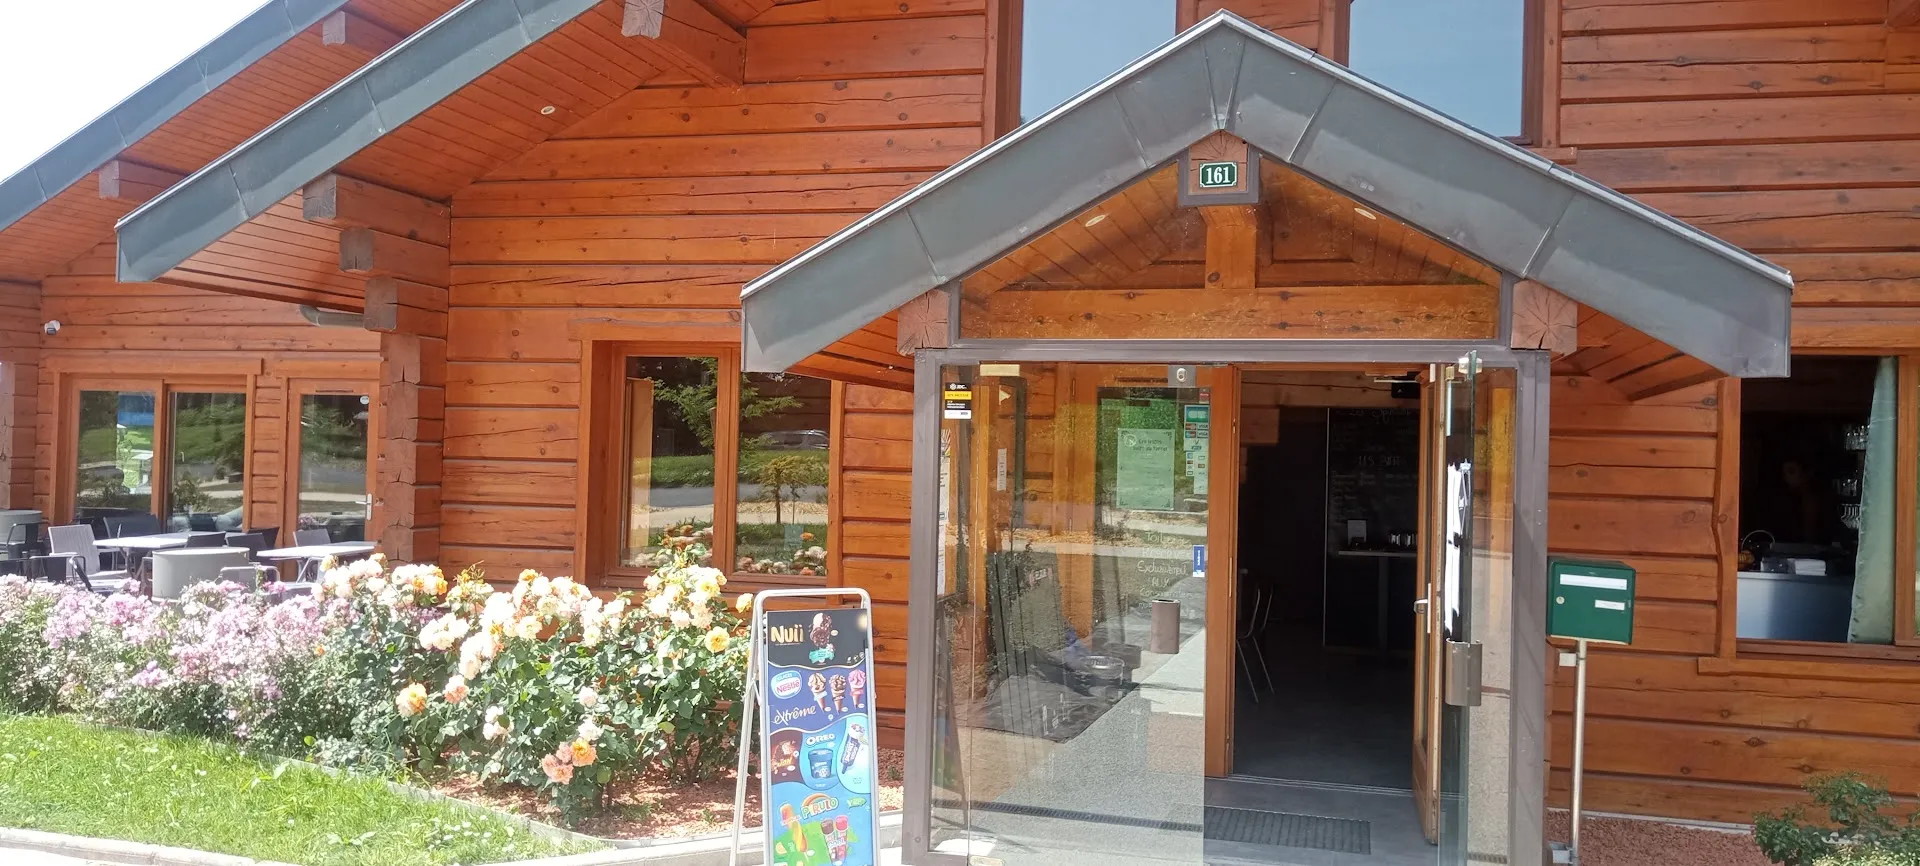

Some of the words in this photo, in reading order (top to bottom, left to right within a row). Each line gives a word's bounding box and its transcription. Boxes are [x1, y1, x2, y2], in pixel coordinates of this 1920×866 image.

[1205, 166, 1231, 184] 161
[770, 624, 804, 643] Nuii
[776, 679, 800, 693] Nestlé
[806, 733, 835, 746] OREO
[801, 797, 838, 819] PIRULO
